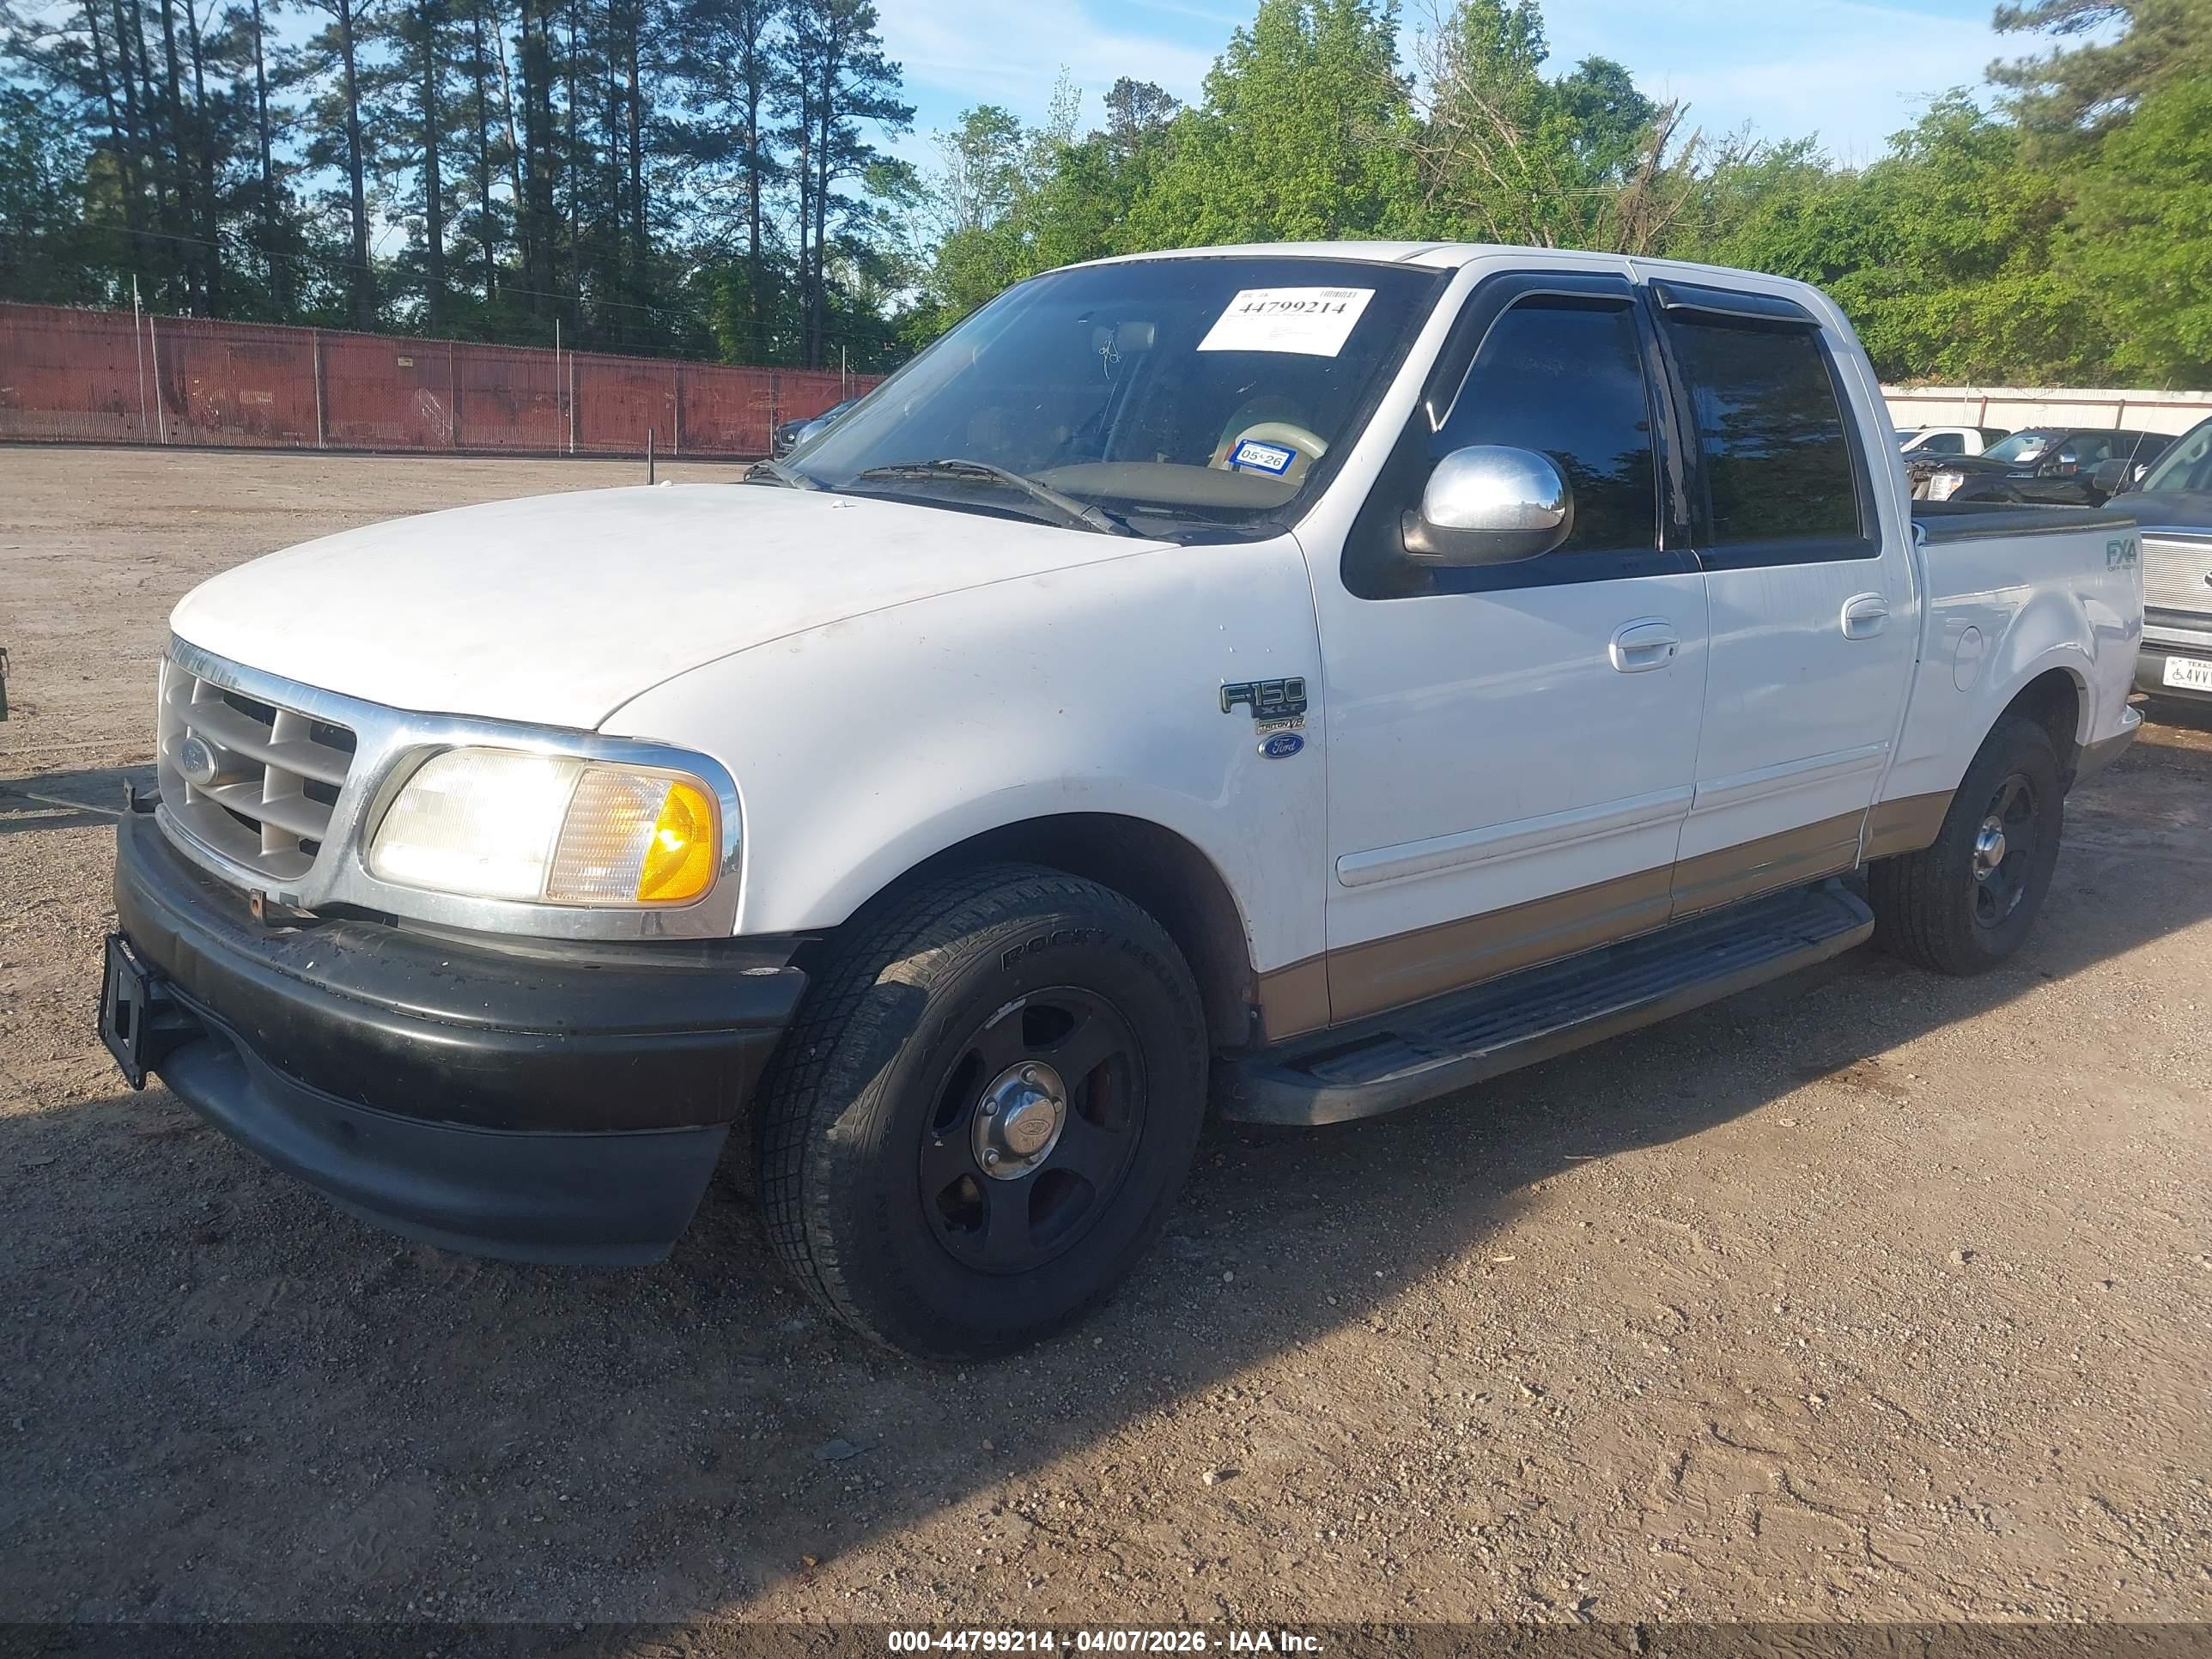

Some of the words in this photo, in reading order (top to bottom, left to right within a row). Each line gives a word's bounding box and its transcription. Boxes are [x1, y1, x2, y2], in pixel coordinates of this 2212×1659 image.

[1238, 301, 1347, 314] 44799214
[2106, 539, 2137, 565] FX4
[2186, 669, 2212, 685] 4VV
[1261, 703, 1302, 714] XLT
[1272, 738, 1297, 754] Ford
